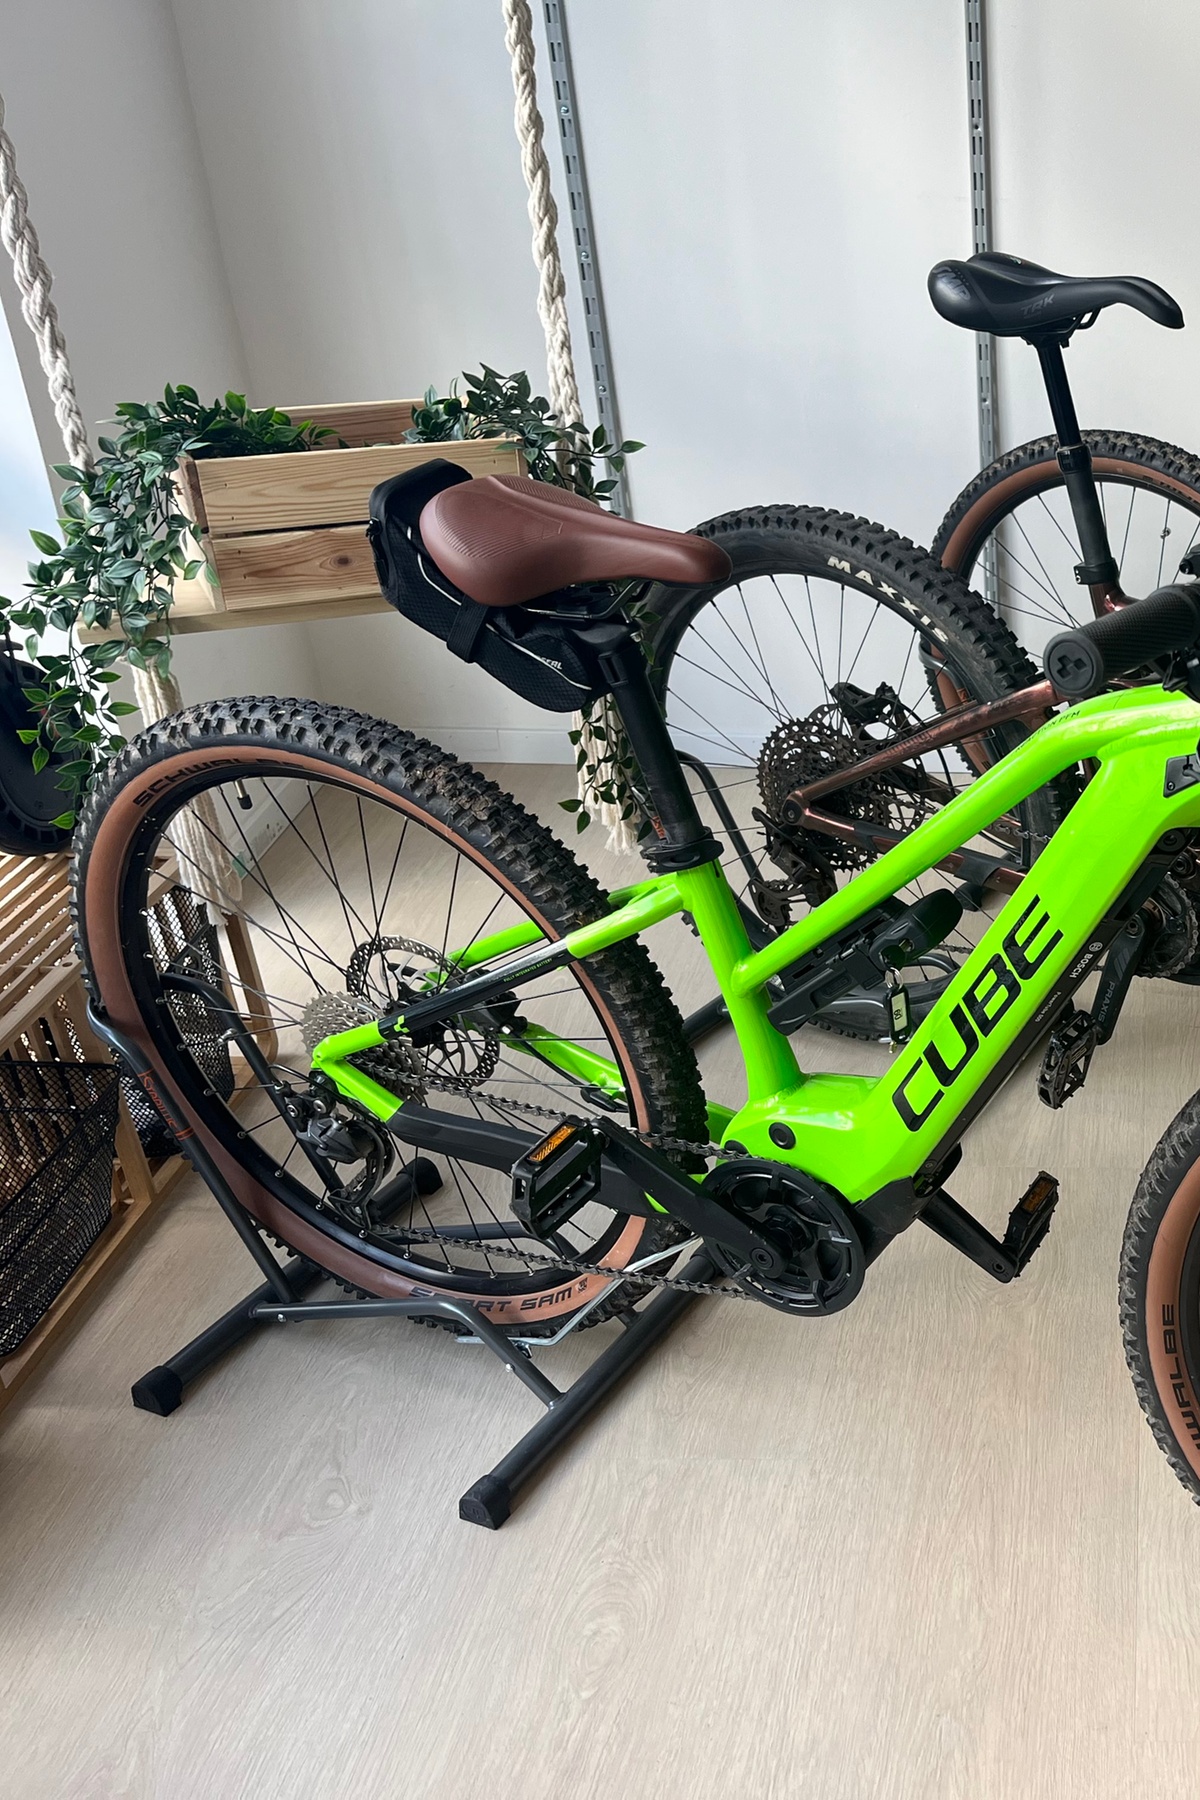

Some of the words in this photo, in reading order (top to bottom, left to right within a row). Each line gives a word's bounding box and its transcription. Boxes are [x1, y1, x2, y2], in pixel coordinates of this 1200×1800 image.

[827, 555, 949, 643] MAXXIS
[1069, 953, 1093, 978] BOSCH
[892, 894, 1064, 1132] CUBE
[1098, 981, 1116, 1023] PRAXIS
[520, 1286, 573, 1311] SAM
